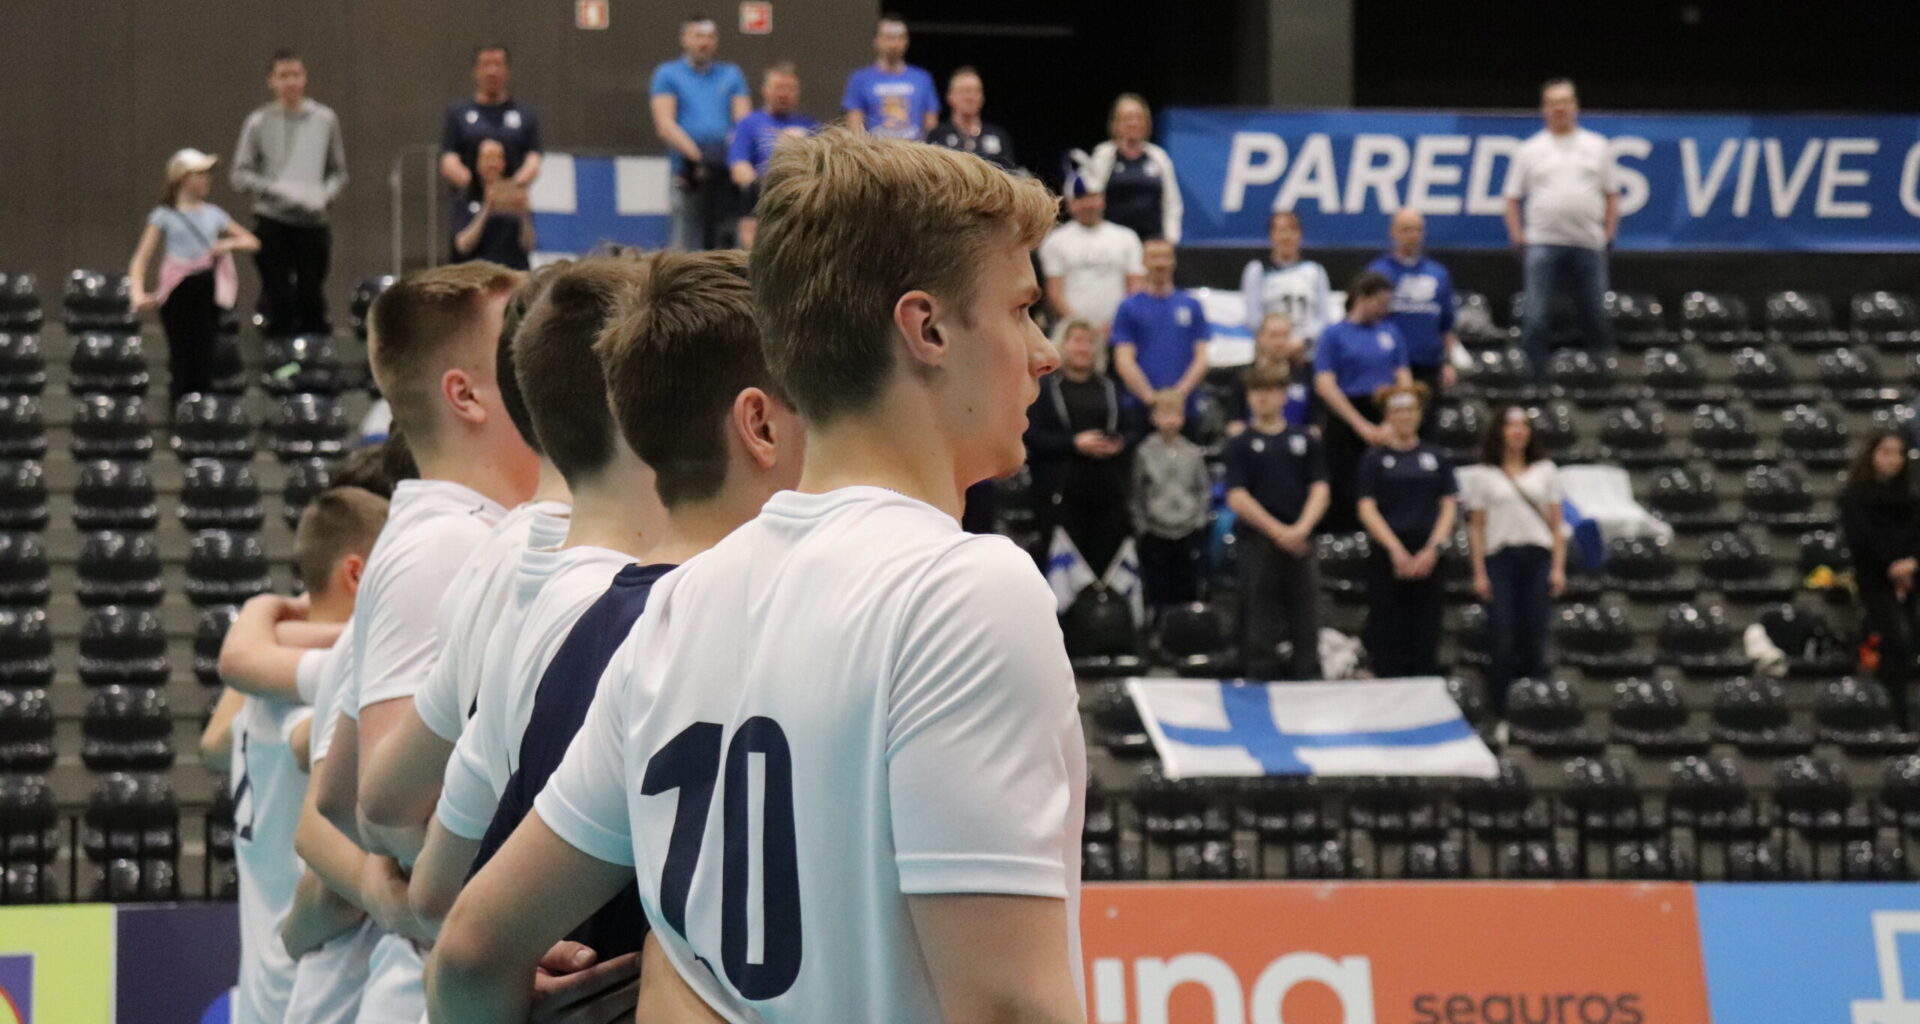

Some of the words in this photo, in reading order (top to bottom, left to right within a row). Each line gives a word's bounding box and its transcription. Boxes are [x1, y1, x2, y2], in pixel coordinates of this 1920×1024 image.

[1222, 132, 1653, 217] PAREDS
[1679, 137, 1880, 219] VIVE
[640, 715, 803, 1001] 10
